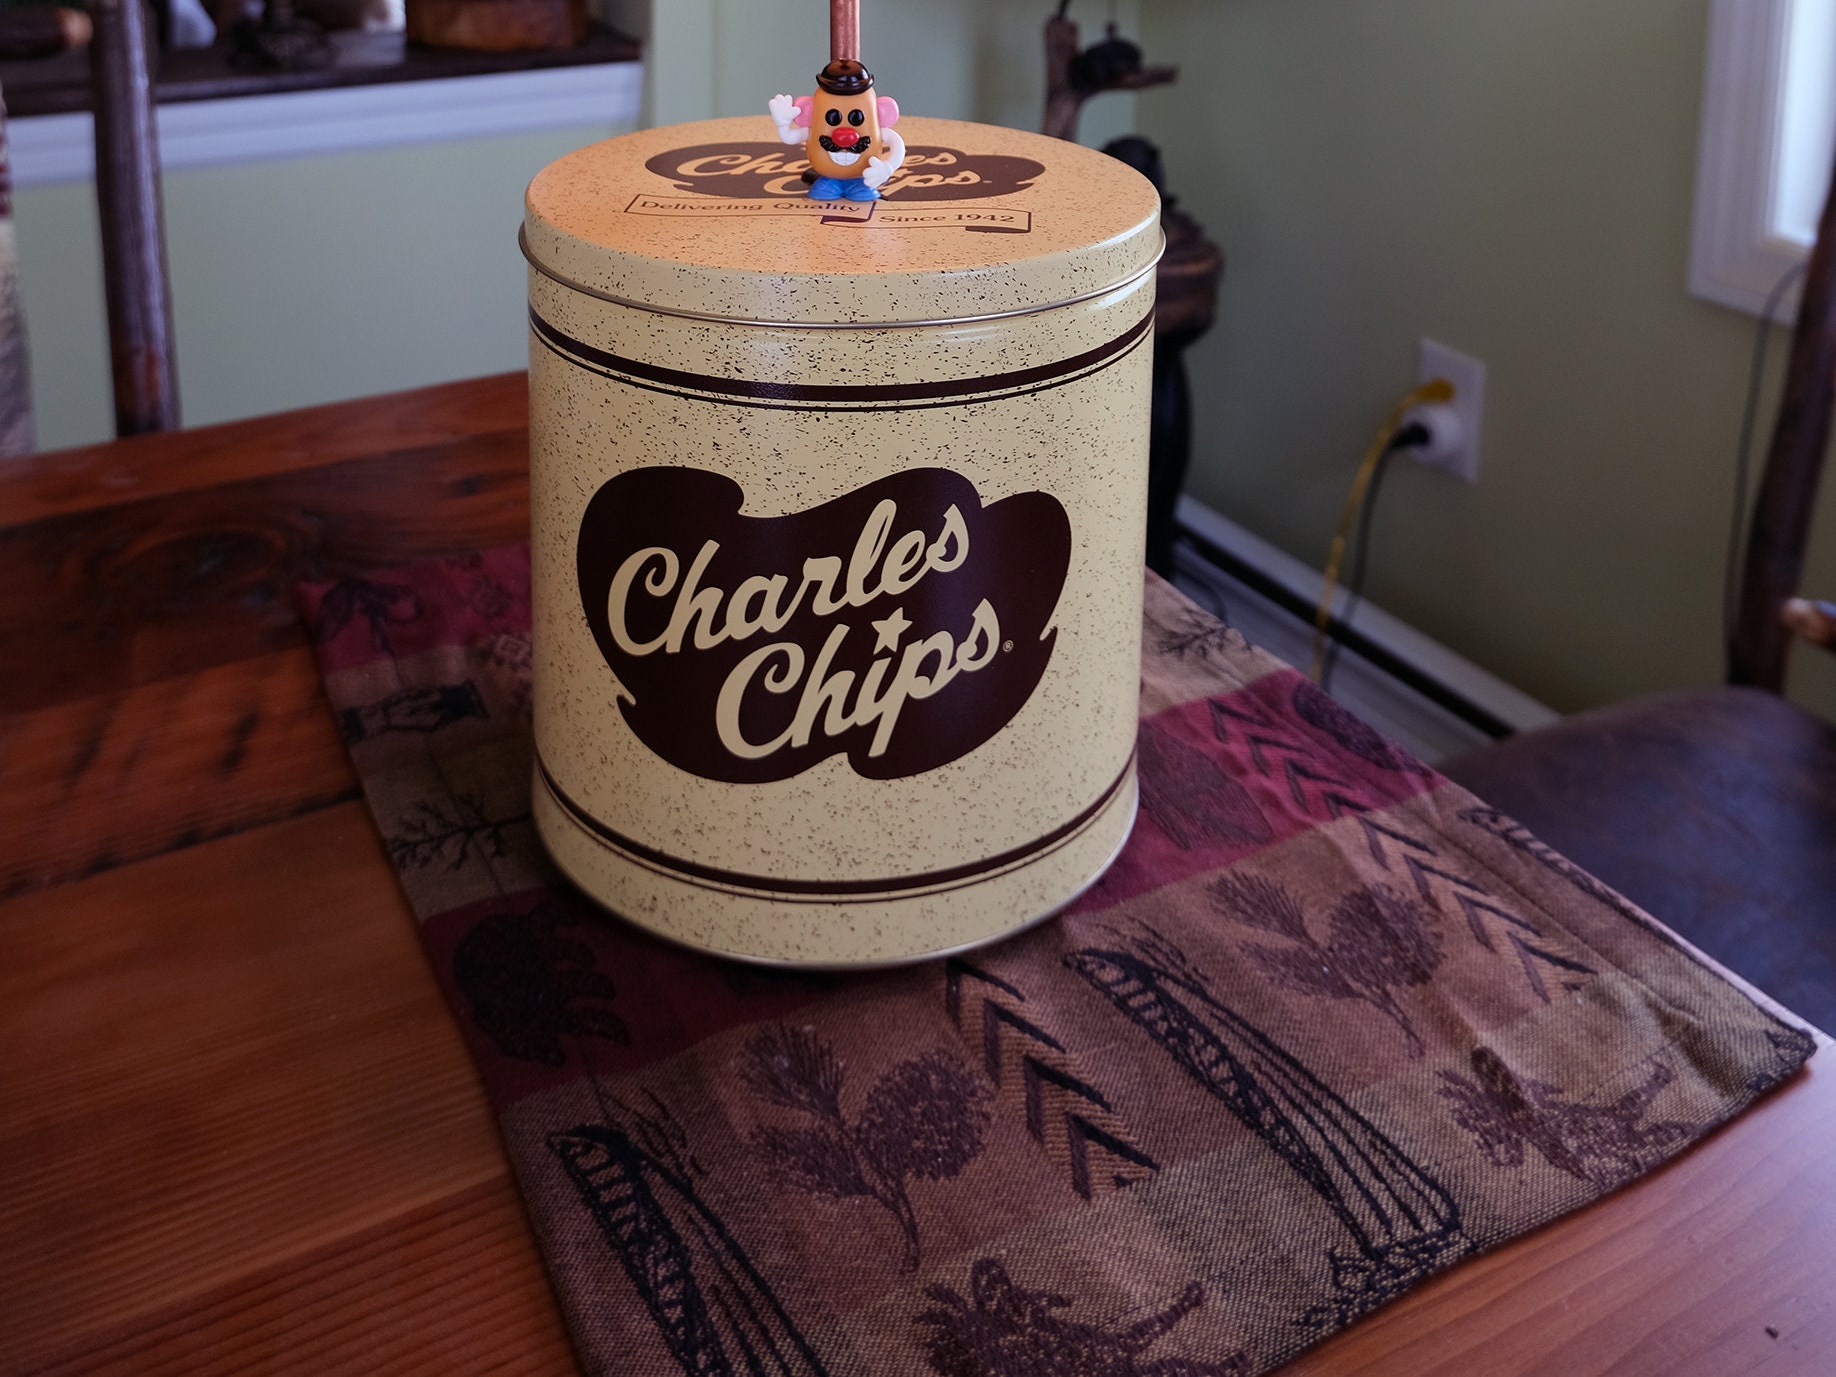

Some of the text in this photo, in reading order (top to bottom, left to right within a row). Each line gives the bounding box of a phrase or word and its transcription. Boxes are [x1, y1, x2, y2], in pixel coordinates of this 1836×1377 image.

[641, 201, 860, 213] Delivering Quality
[879, 213, 1016, 224] Since 1942
[607, 498, 970, 656] Charles
